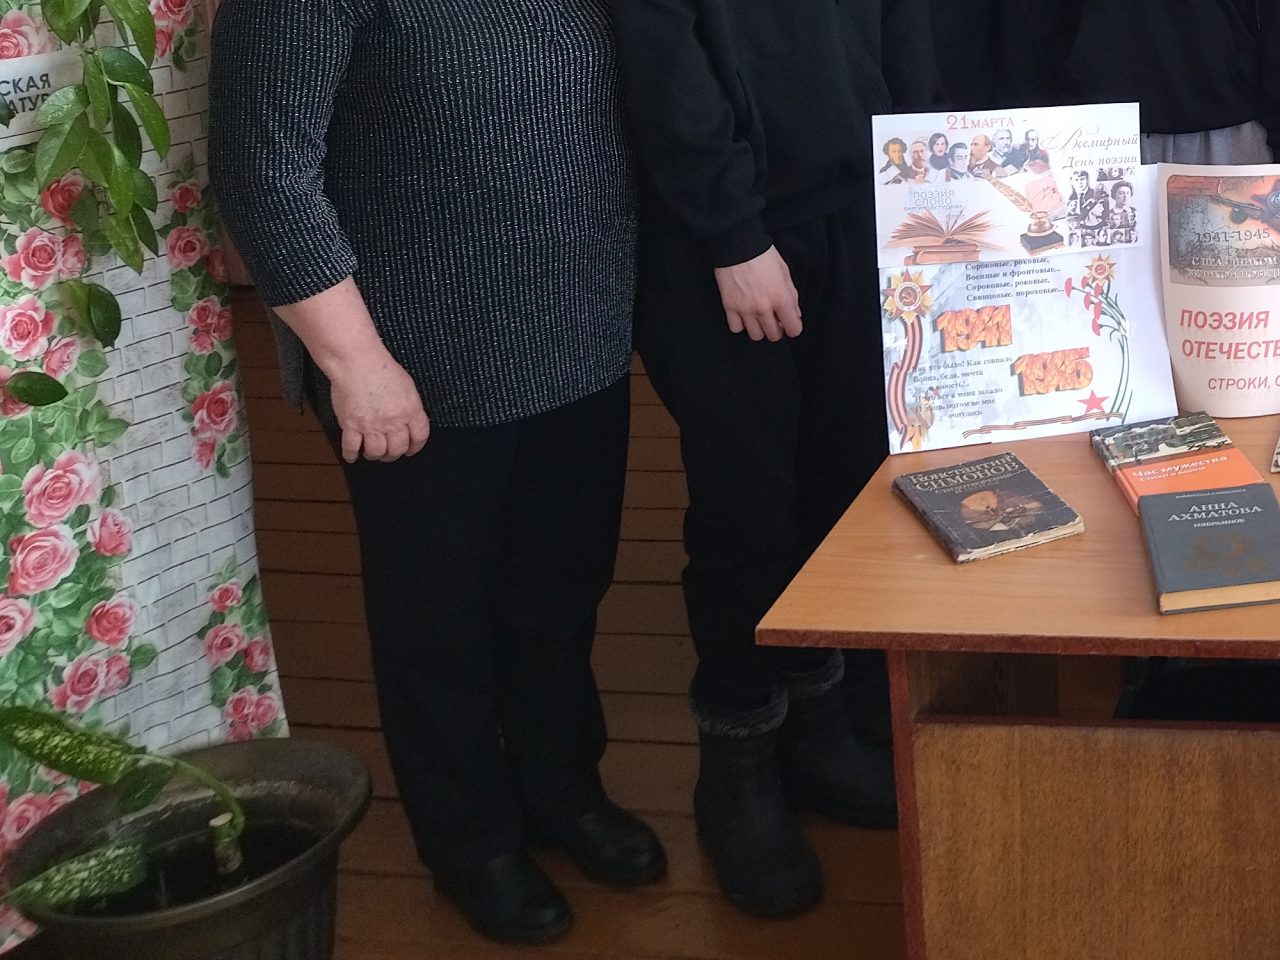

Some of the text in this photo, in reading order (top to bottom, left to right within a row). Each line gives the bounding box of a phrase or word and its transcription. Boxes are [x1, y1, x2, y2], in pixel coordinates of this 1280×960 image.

[947, 114, 968, 129] 21
[913, 190, 954, 199] ПОЭЗИЯ
[935, 304, 1013, 353] 1941
[1180, 309, 1270, 330] ПОЭЗИЯ
[1011, 347, 1093, 396] 1945
[1208, 375, 1271, 391] СТРОКИ,
[1133, 456, 1228, 477] Час мужества
[915, 461, 1019, 491] СИМОНОВ
[1168, 506, 1263, 521] АХМАТОВА
[1189, 501, 1239, 513] АННА
